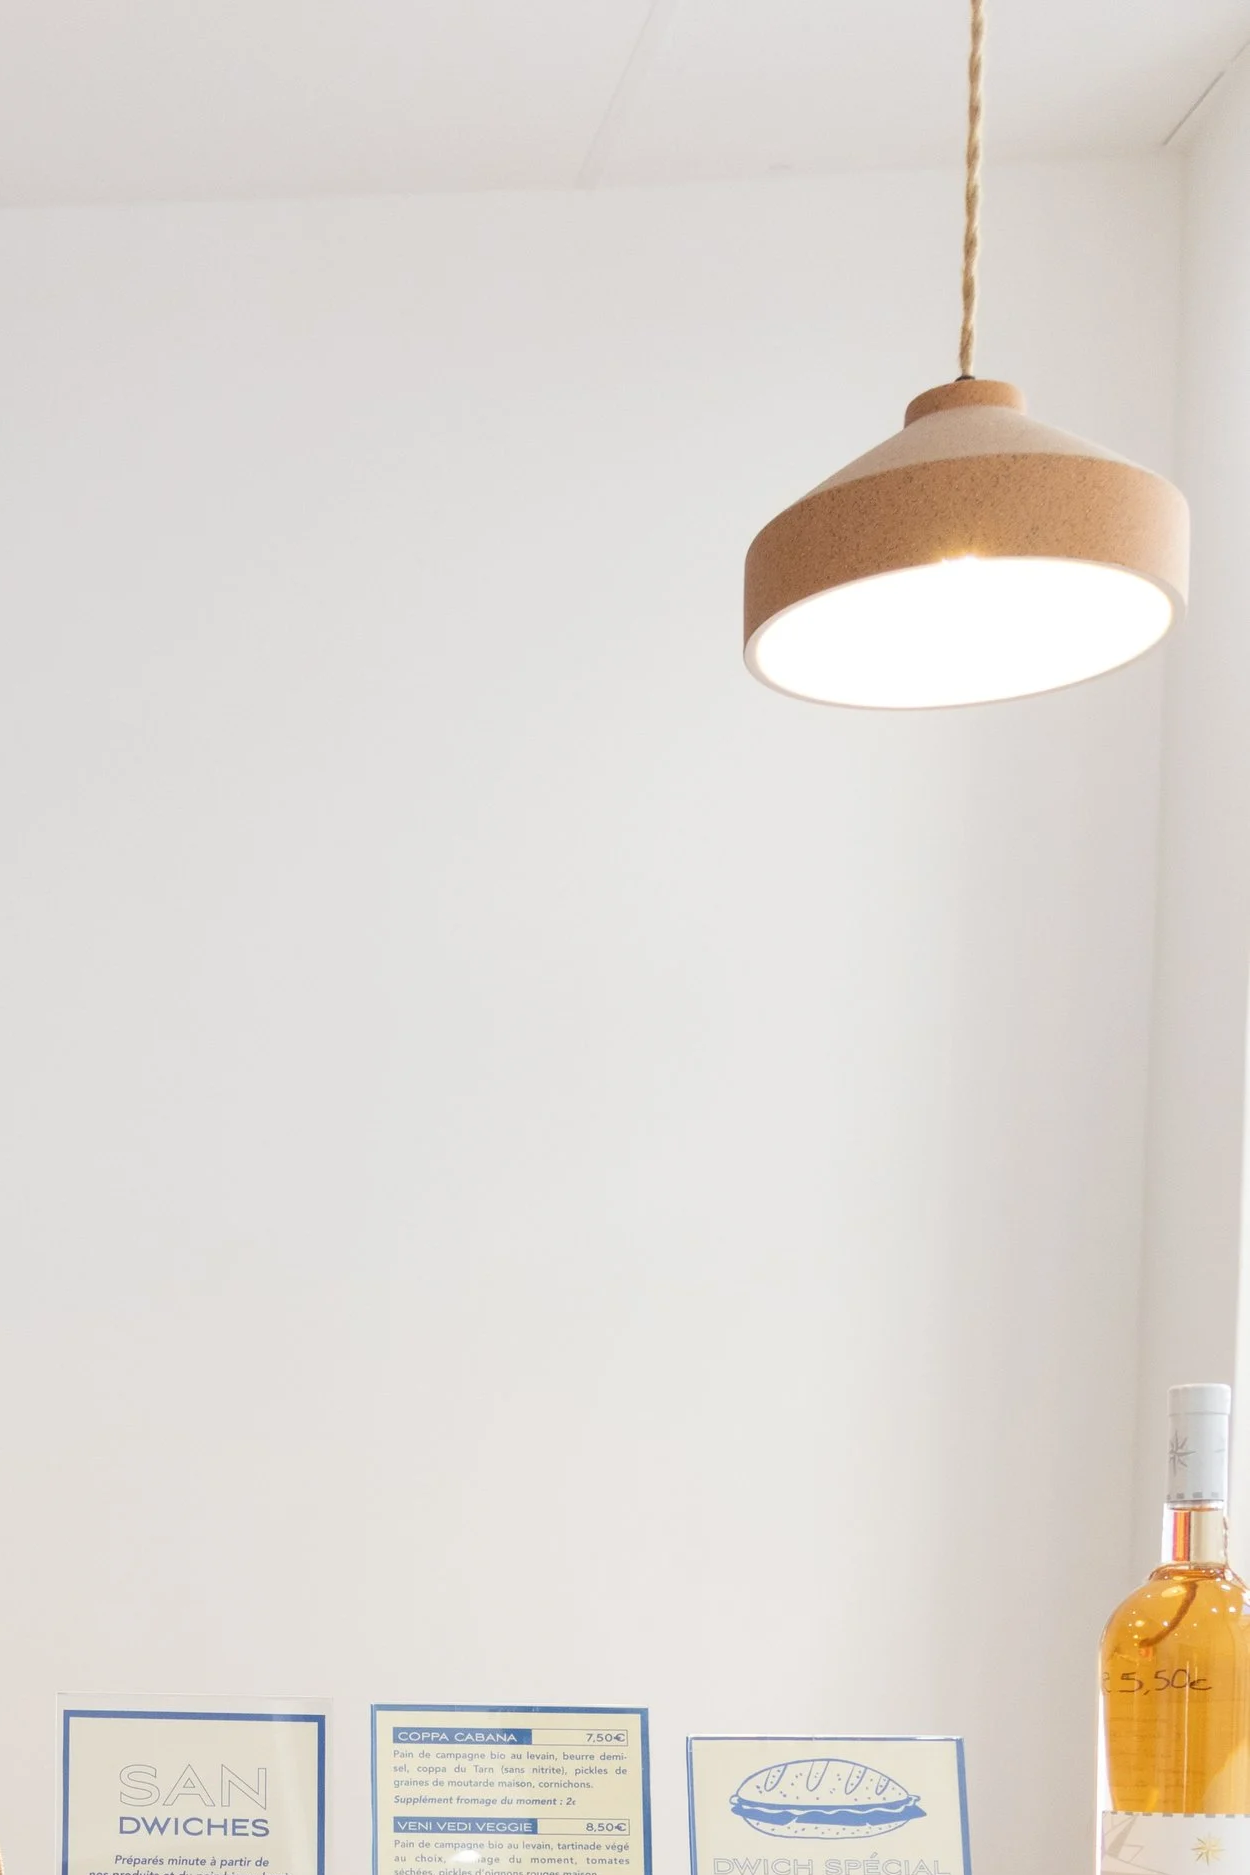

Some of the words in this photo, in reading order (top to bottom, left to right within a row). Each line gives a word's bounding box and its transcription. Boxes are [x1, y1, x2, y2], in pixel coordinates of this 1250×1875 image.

[398, 1732, 450, 1742] COPPA
[455, 1732, 518, 1743] CABANA
[586, 1733, 625, 1743] 7,50€
[119, 1763, 267, 1811] SAN
[394, 1795, 453, 1806] Supplément
[456, 1795, 497, 1807] fromage
[500, 1796, 513, 1805] du
[566, 1797, 576, 1806] 2€
[119, 1816, 270, 1837] DWICHES
[398, 1821, 432, 1831] VENI
[437, 1822, 471, 1832] VEDI
[476, 1822, 533, 1833] VEGGIE
[586, 1822, 626, 1832] 8,50€
[115, 1854, 164, 1867] Préparés
[168, 1856, 207, 1866] minute
[210, 1856, 216, 1866] à
[220, 1857, 252, 1869] partir
[255, 1857, 269, 1867] de
